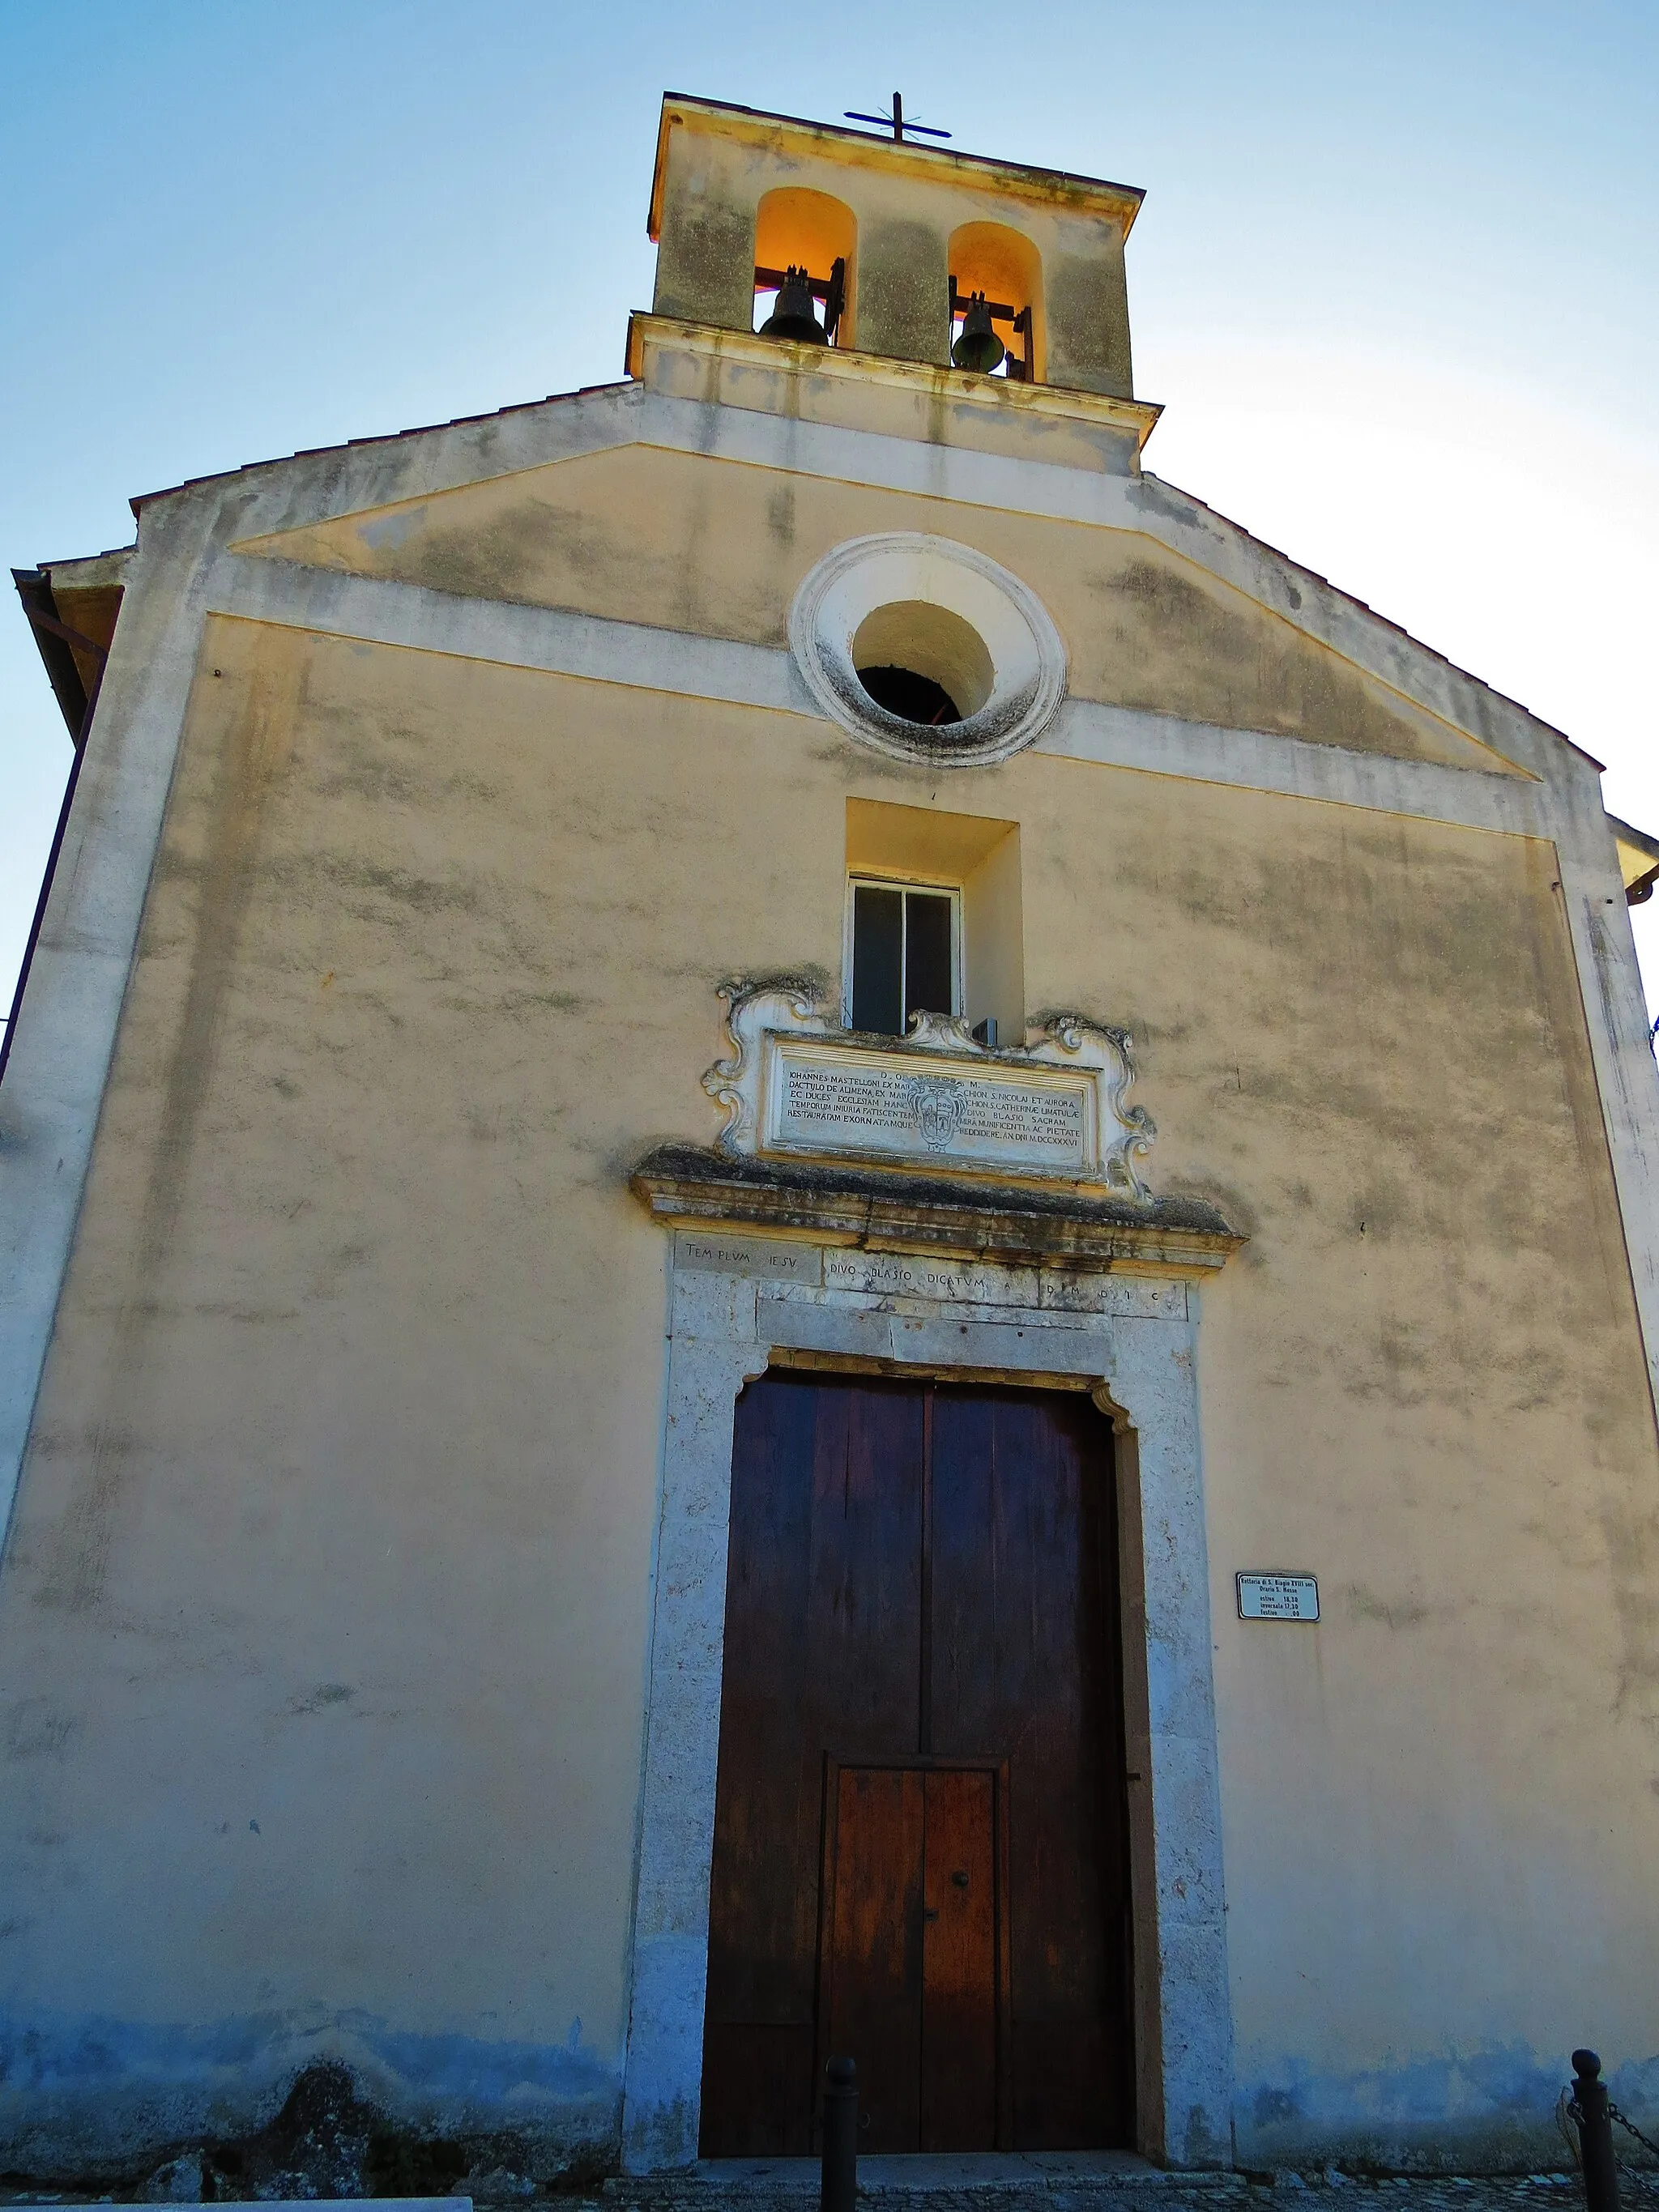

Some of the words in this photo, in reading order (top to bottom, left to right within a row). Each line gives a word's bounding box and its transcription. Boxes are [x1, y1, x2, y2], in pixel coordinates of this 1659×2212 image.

[830, 1076, 880, 1088] MASTELLONI
[1031, 1097, 1043, 1105] ET
[1044, 1098, 1075, 1108] AURORA
[889, 1092, 906, 1100] MAR
[787, 1110, 841, 1122] RESTAURATAM
[843, 1115, 914, 1129] EXORNATAMQUE
[789, 1100, 831, 1110] TEMPORUM
[833, 1104, 861, 1114] INIURIA
[862, 1107, 915, 1119] FATISCENTEM
[978, 1119, 1030, 1132] MUNIFICENTIA
[1033, 1126, 1043, 1134] AC
[1047, 1127, 1081, 1138] PIETATE
[805, 1092, 831, 1102] DUCES
[837, 1095, 879, 1106] ECCLESIAM
[884, 1101, 908, 1109] HANC
[966, 1109, 986, 1118] DIVO
[993, 1112, 1024, 1122] BLASIO
[1031, 1116, 1067, 1127] SACRAM
[830, 1264, 856, 1275] DIVO
[871, 1268, 913, 1281] BLASIO
[927, 1273, 985, 1288] DICATVM
[1274, 1579, 1290, 1588] Biagio
